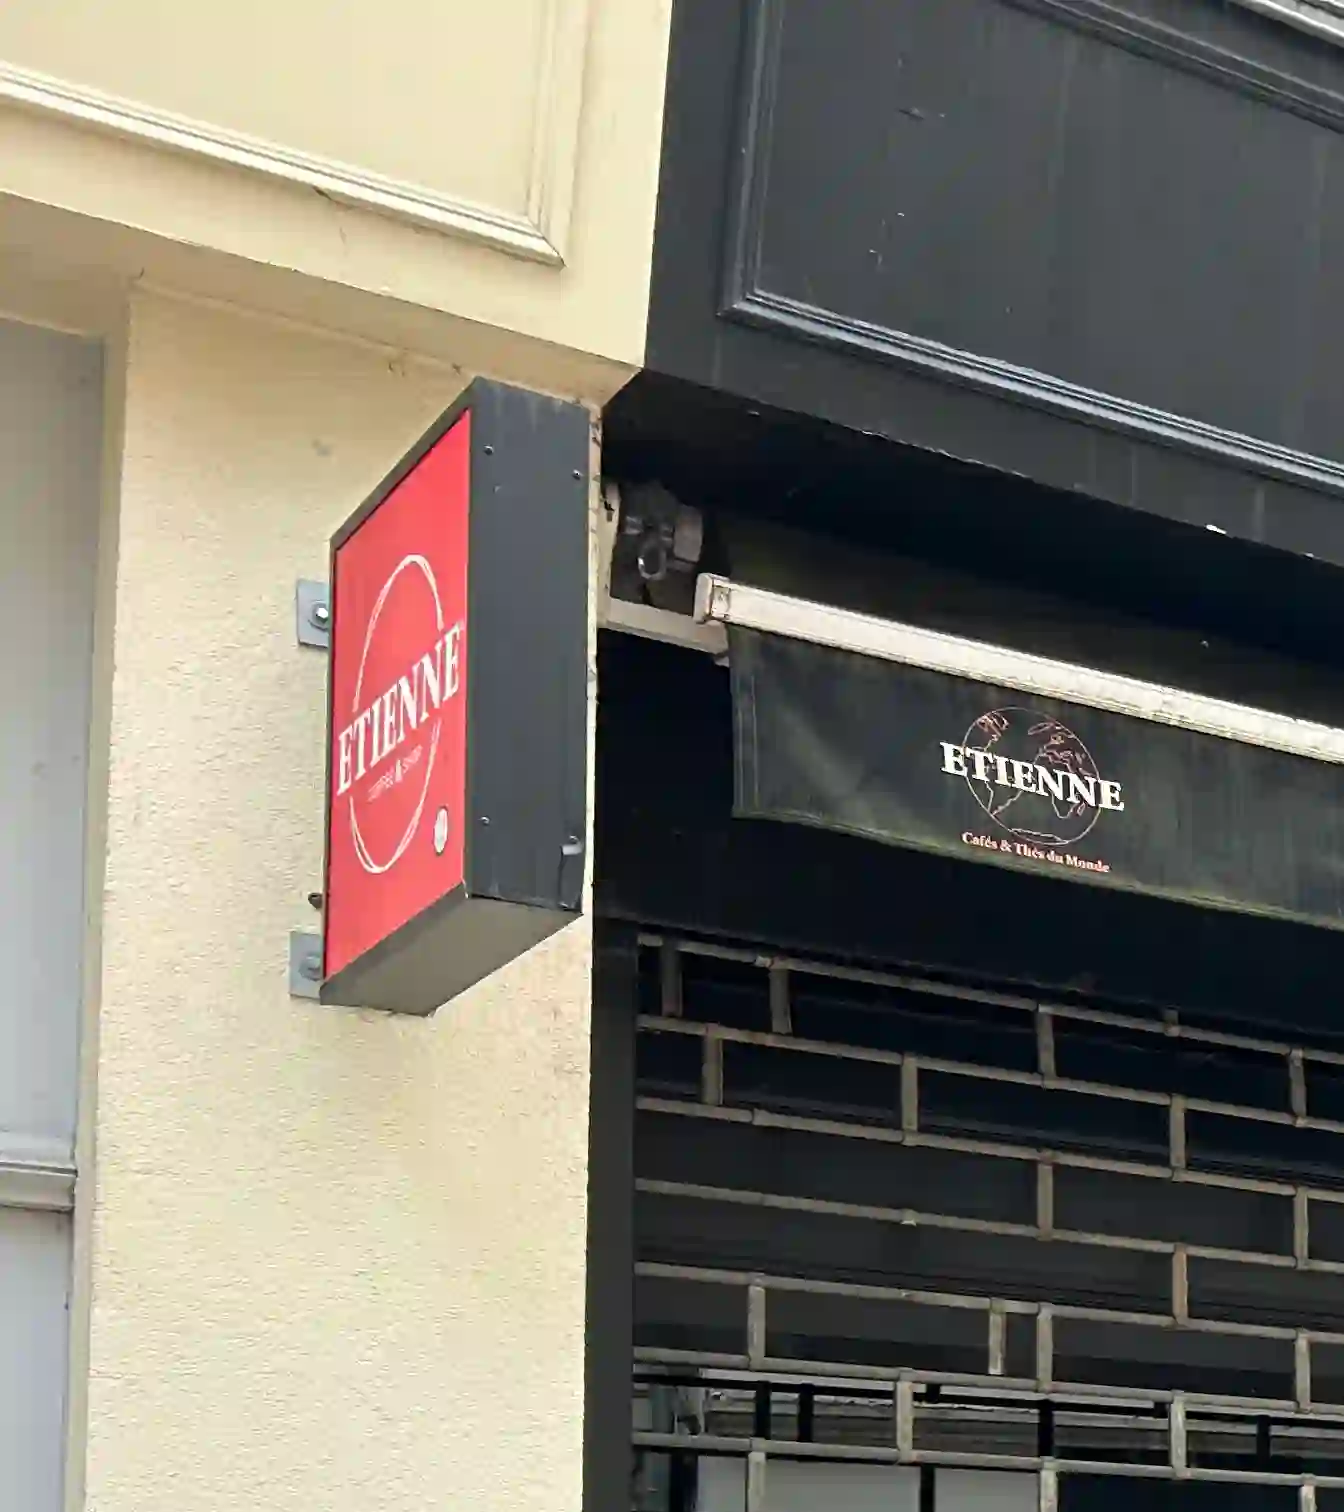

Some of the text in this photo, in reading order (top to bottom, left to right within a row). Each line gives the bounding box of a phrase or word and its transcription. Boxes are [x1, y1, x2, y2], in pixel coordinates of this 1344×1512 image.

[337, 619, 463, 796] ETIENNE
[940, 741, 1125, 811] ETIENNE
[1047, 851, 1064, 864] du
[1066, 853, 1110, 873] Monde
